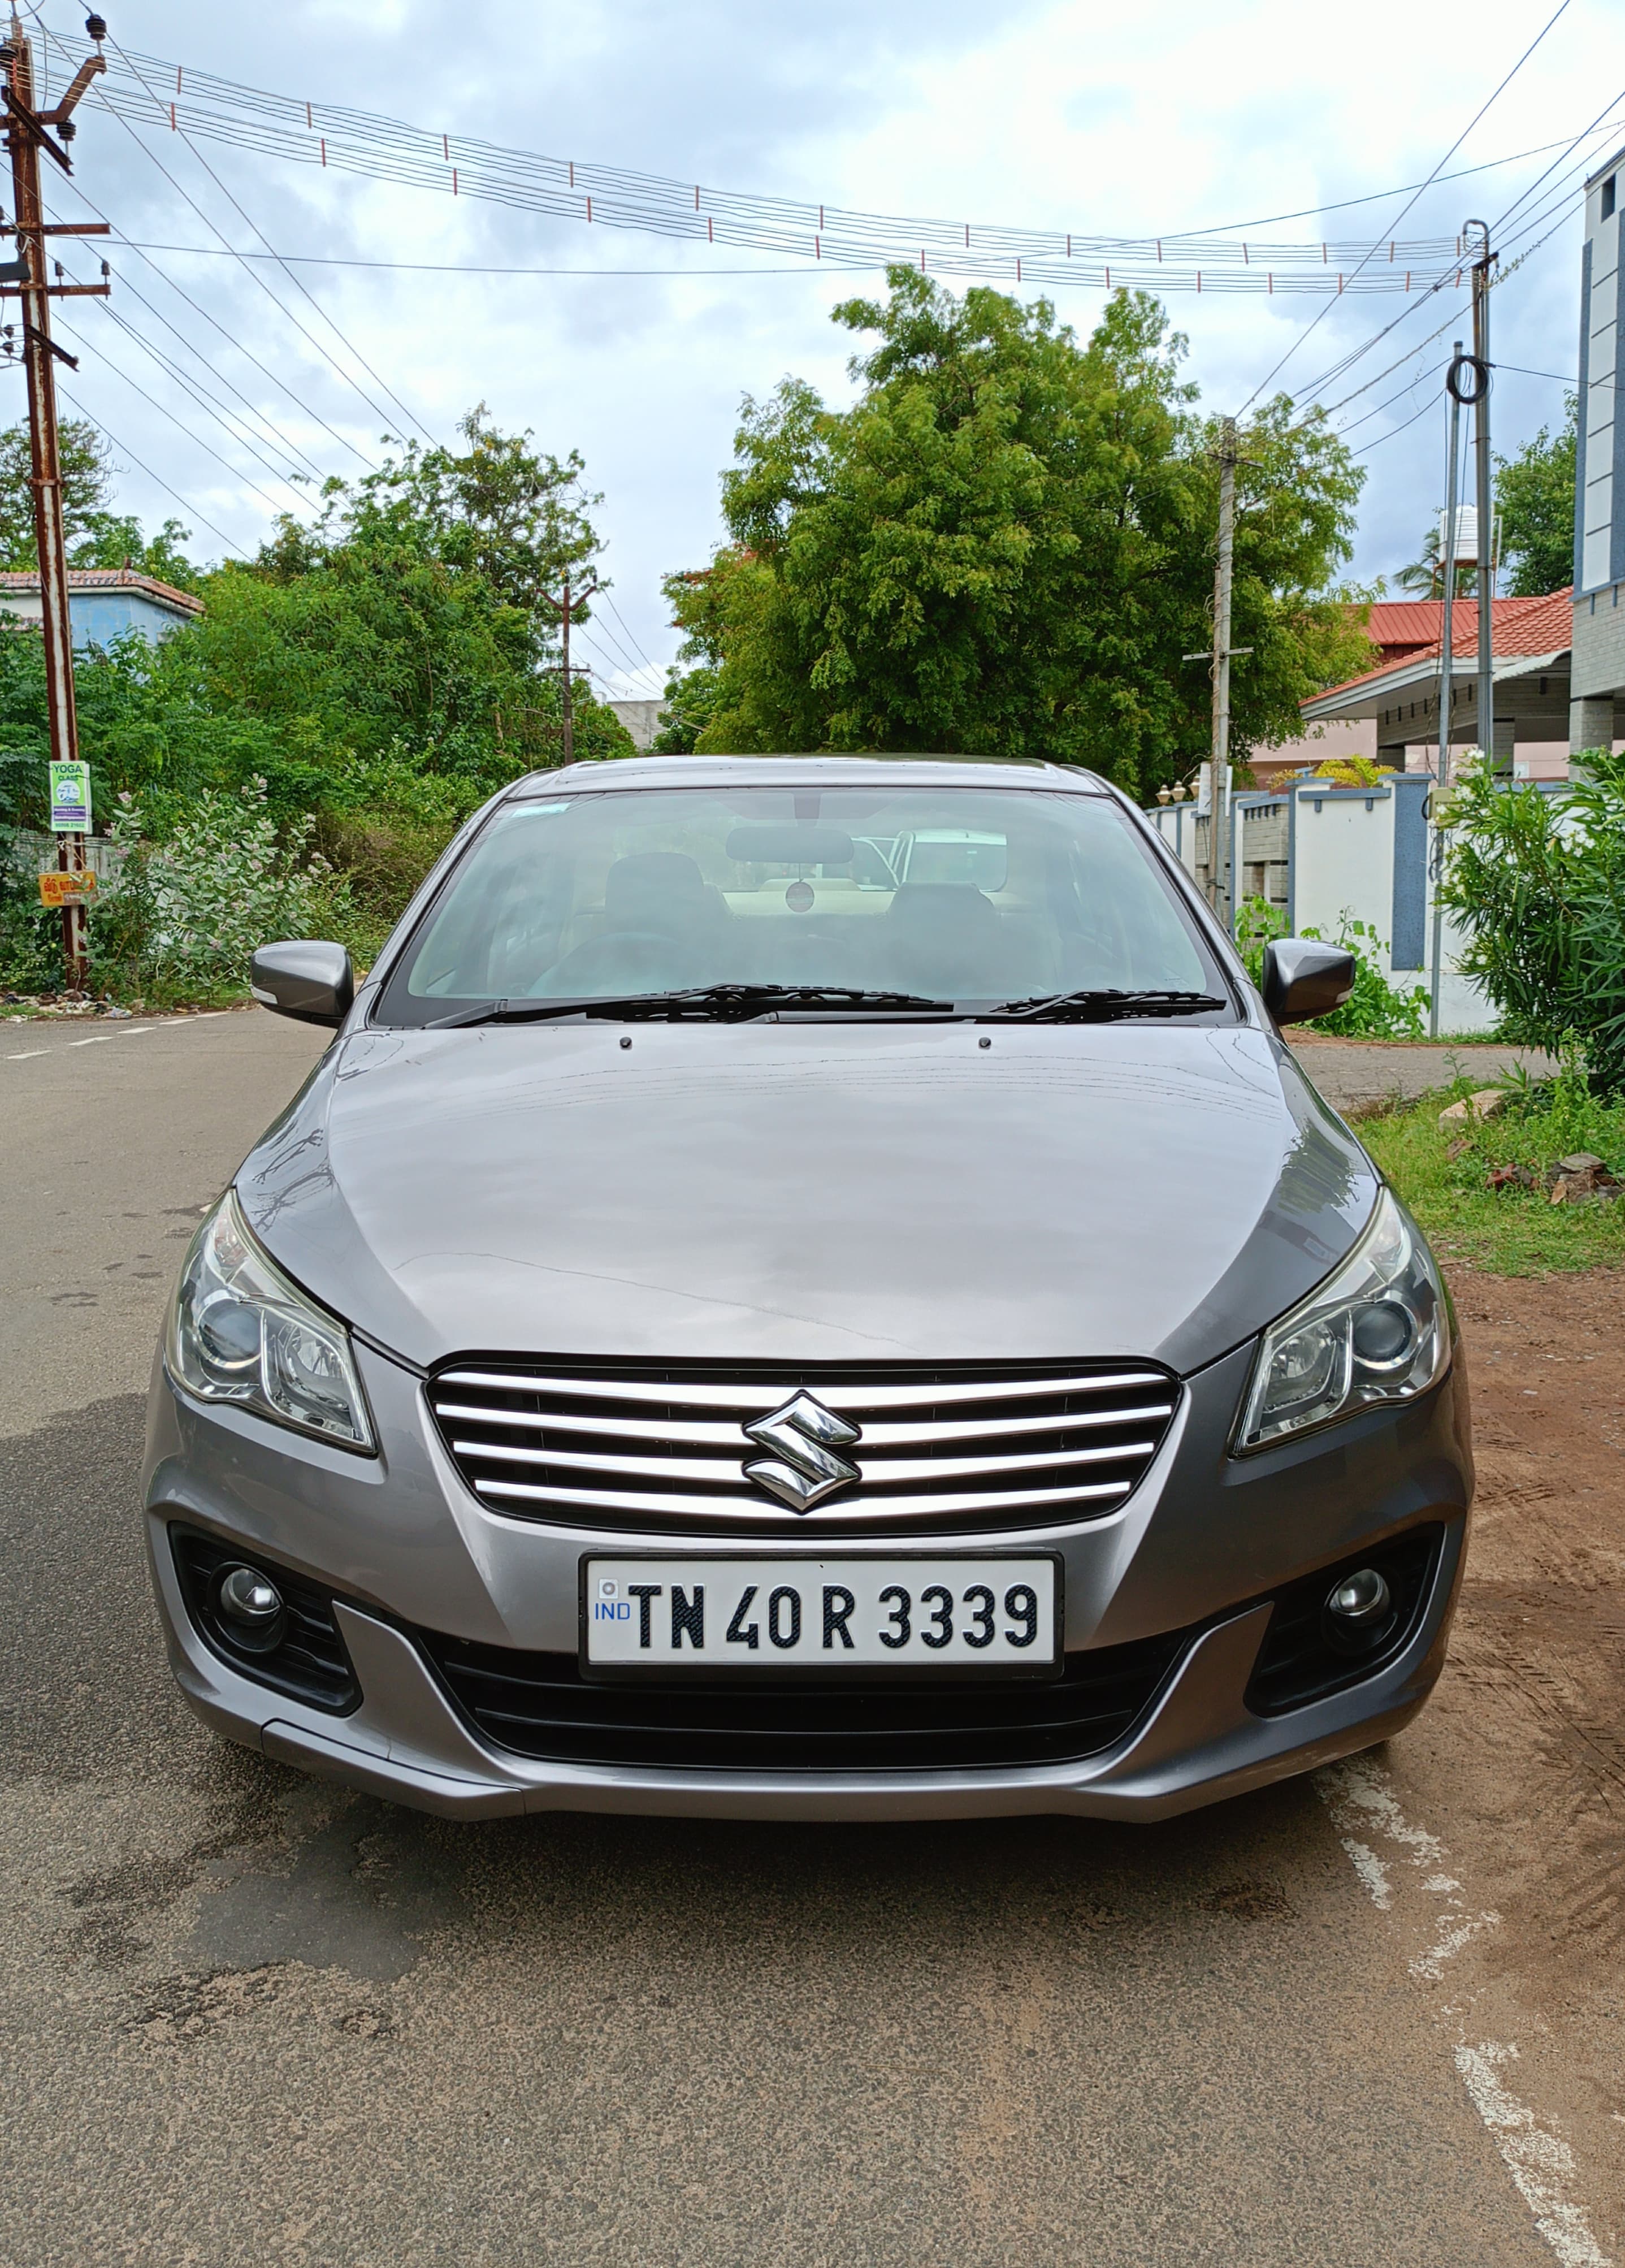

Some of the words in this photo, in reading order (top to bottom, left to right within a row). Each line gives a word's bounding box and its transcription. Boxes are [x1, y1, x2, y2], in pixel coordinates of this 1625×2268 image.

[595, 1603, 630, 1620] IND
[628, 1585, 705, 1648] TN
[726, 1585, 802, 1649] 40
[822, 1585, 856, 1648] R
[878, 1584, 1038, 1648] 3339
